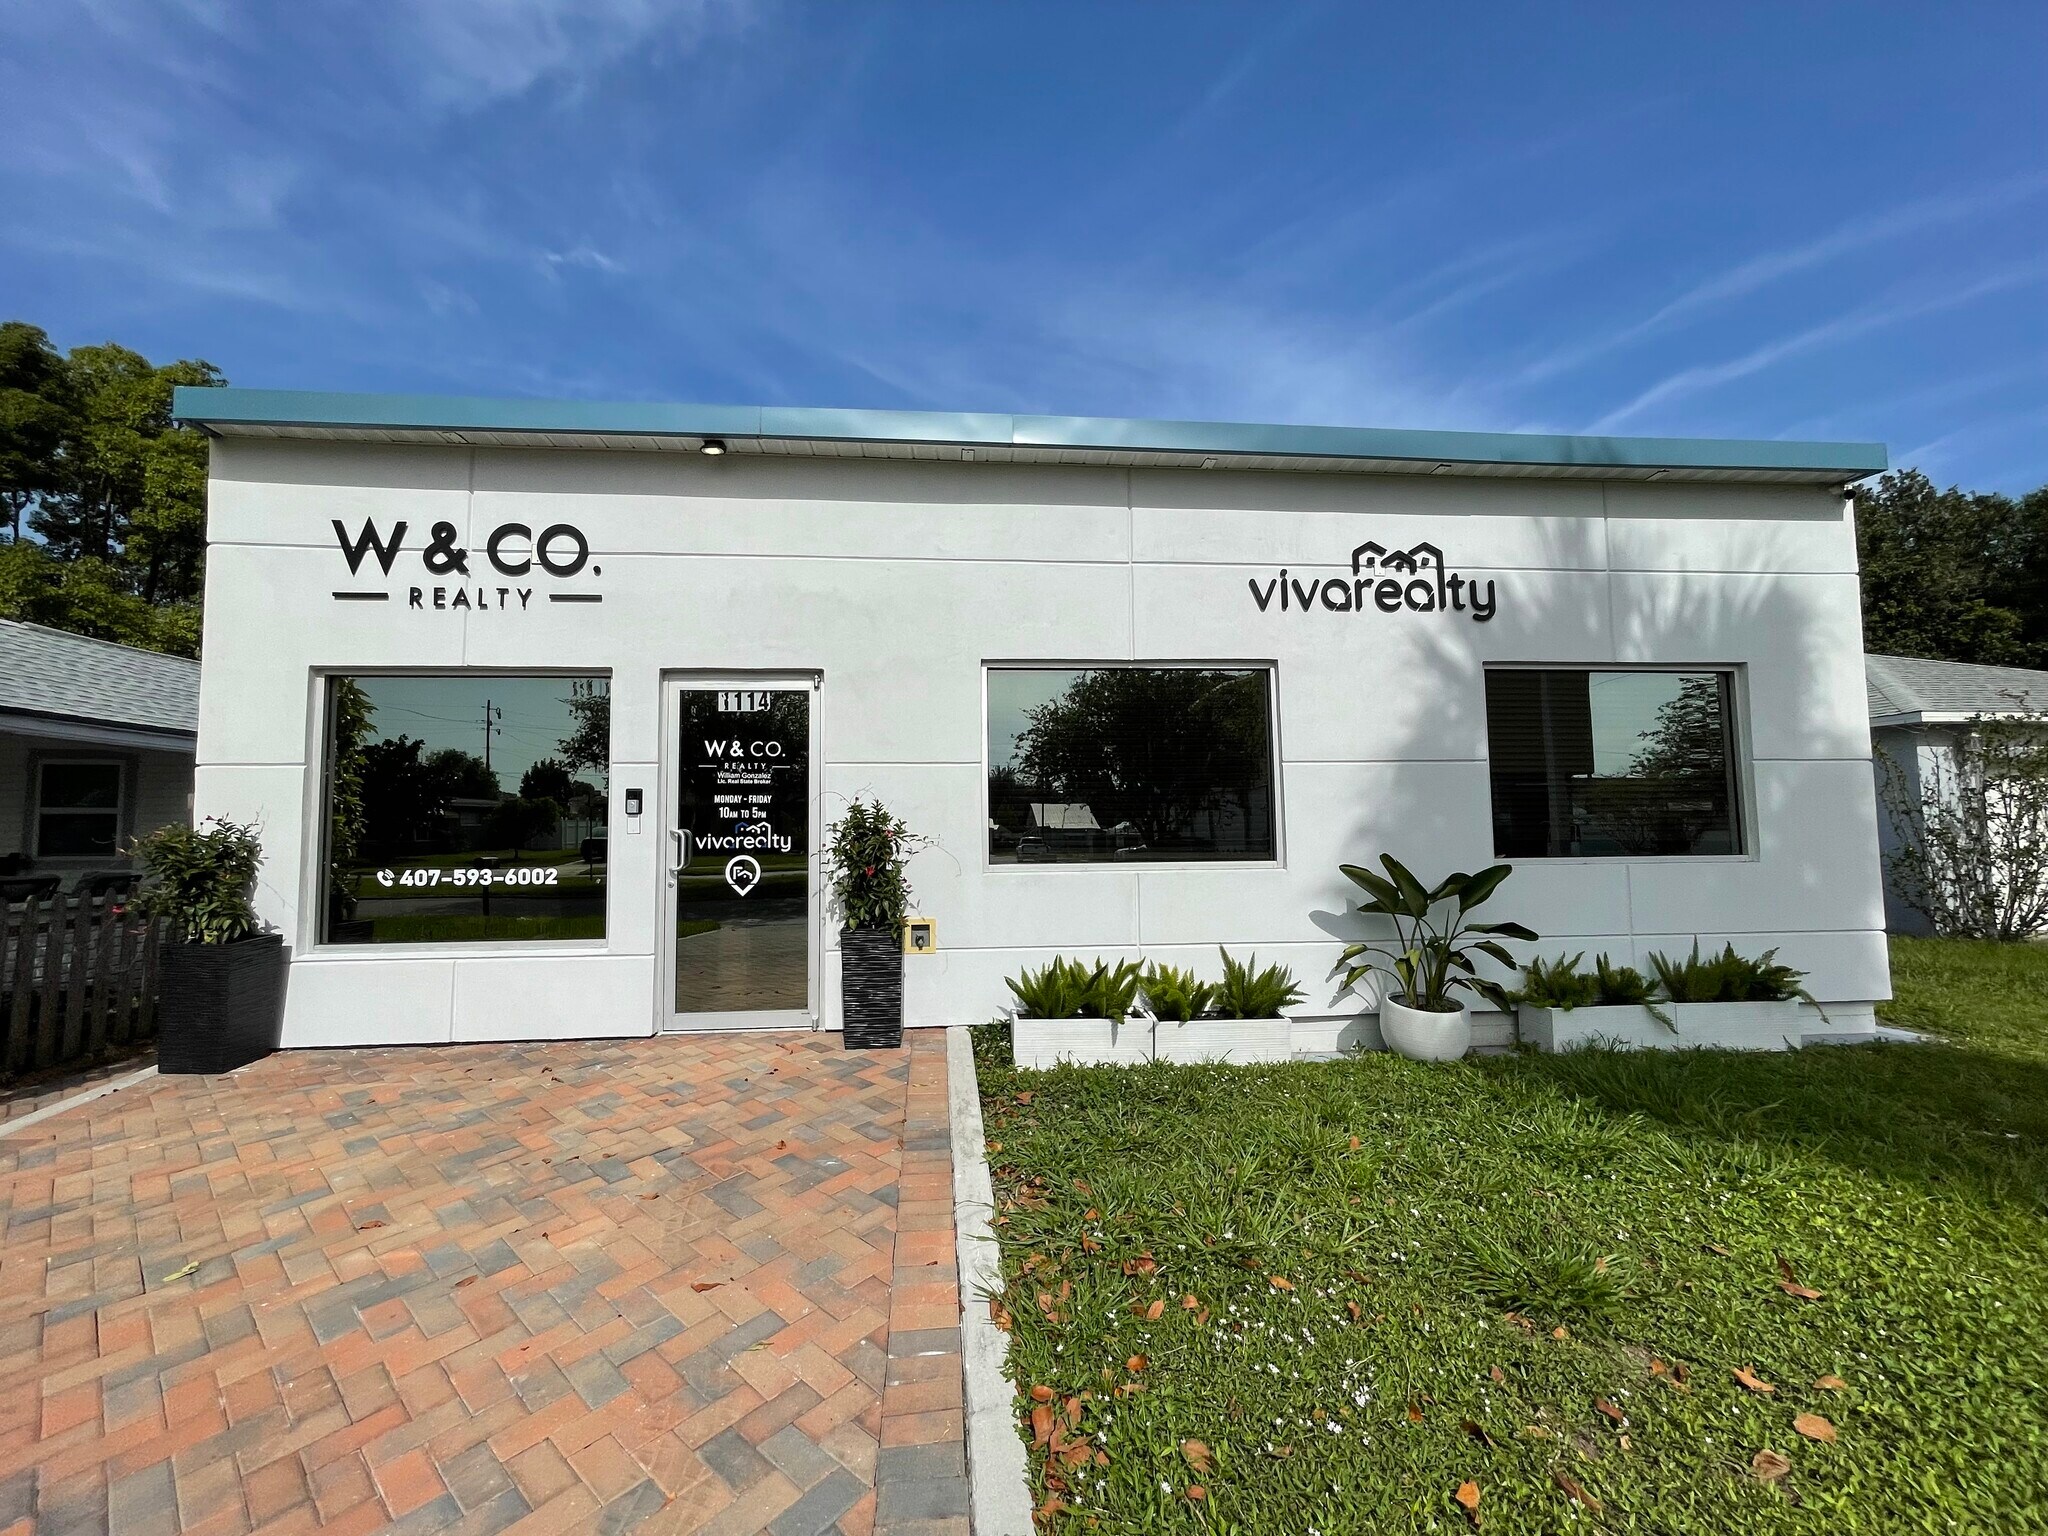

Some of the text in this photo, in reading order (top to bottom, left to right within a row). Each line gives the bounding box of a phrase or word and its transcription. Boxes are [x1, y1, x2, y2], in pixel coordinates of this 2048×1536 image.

[331, 516, 602, 578] W & CO.
[1248, 547, 1496, 622] vivarealty
[409, 586, 533, 611] REALTY
[721, 691, 770, 711] 1114
[704, 740, 786, 757] W & CO.
[717, 771, 740, 779] William
[724, 762, 767, 770] REALTY
[714, 795, 742, 804] MONDAY
[748, 795, 772, 803] FRIDAY
[719, 806, 767, 818] 10AM TO 5PM
[695, 826, 792, 853] vivarealty
[399, 868, 558, 887] 407-593-6002
